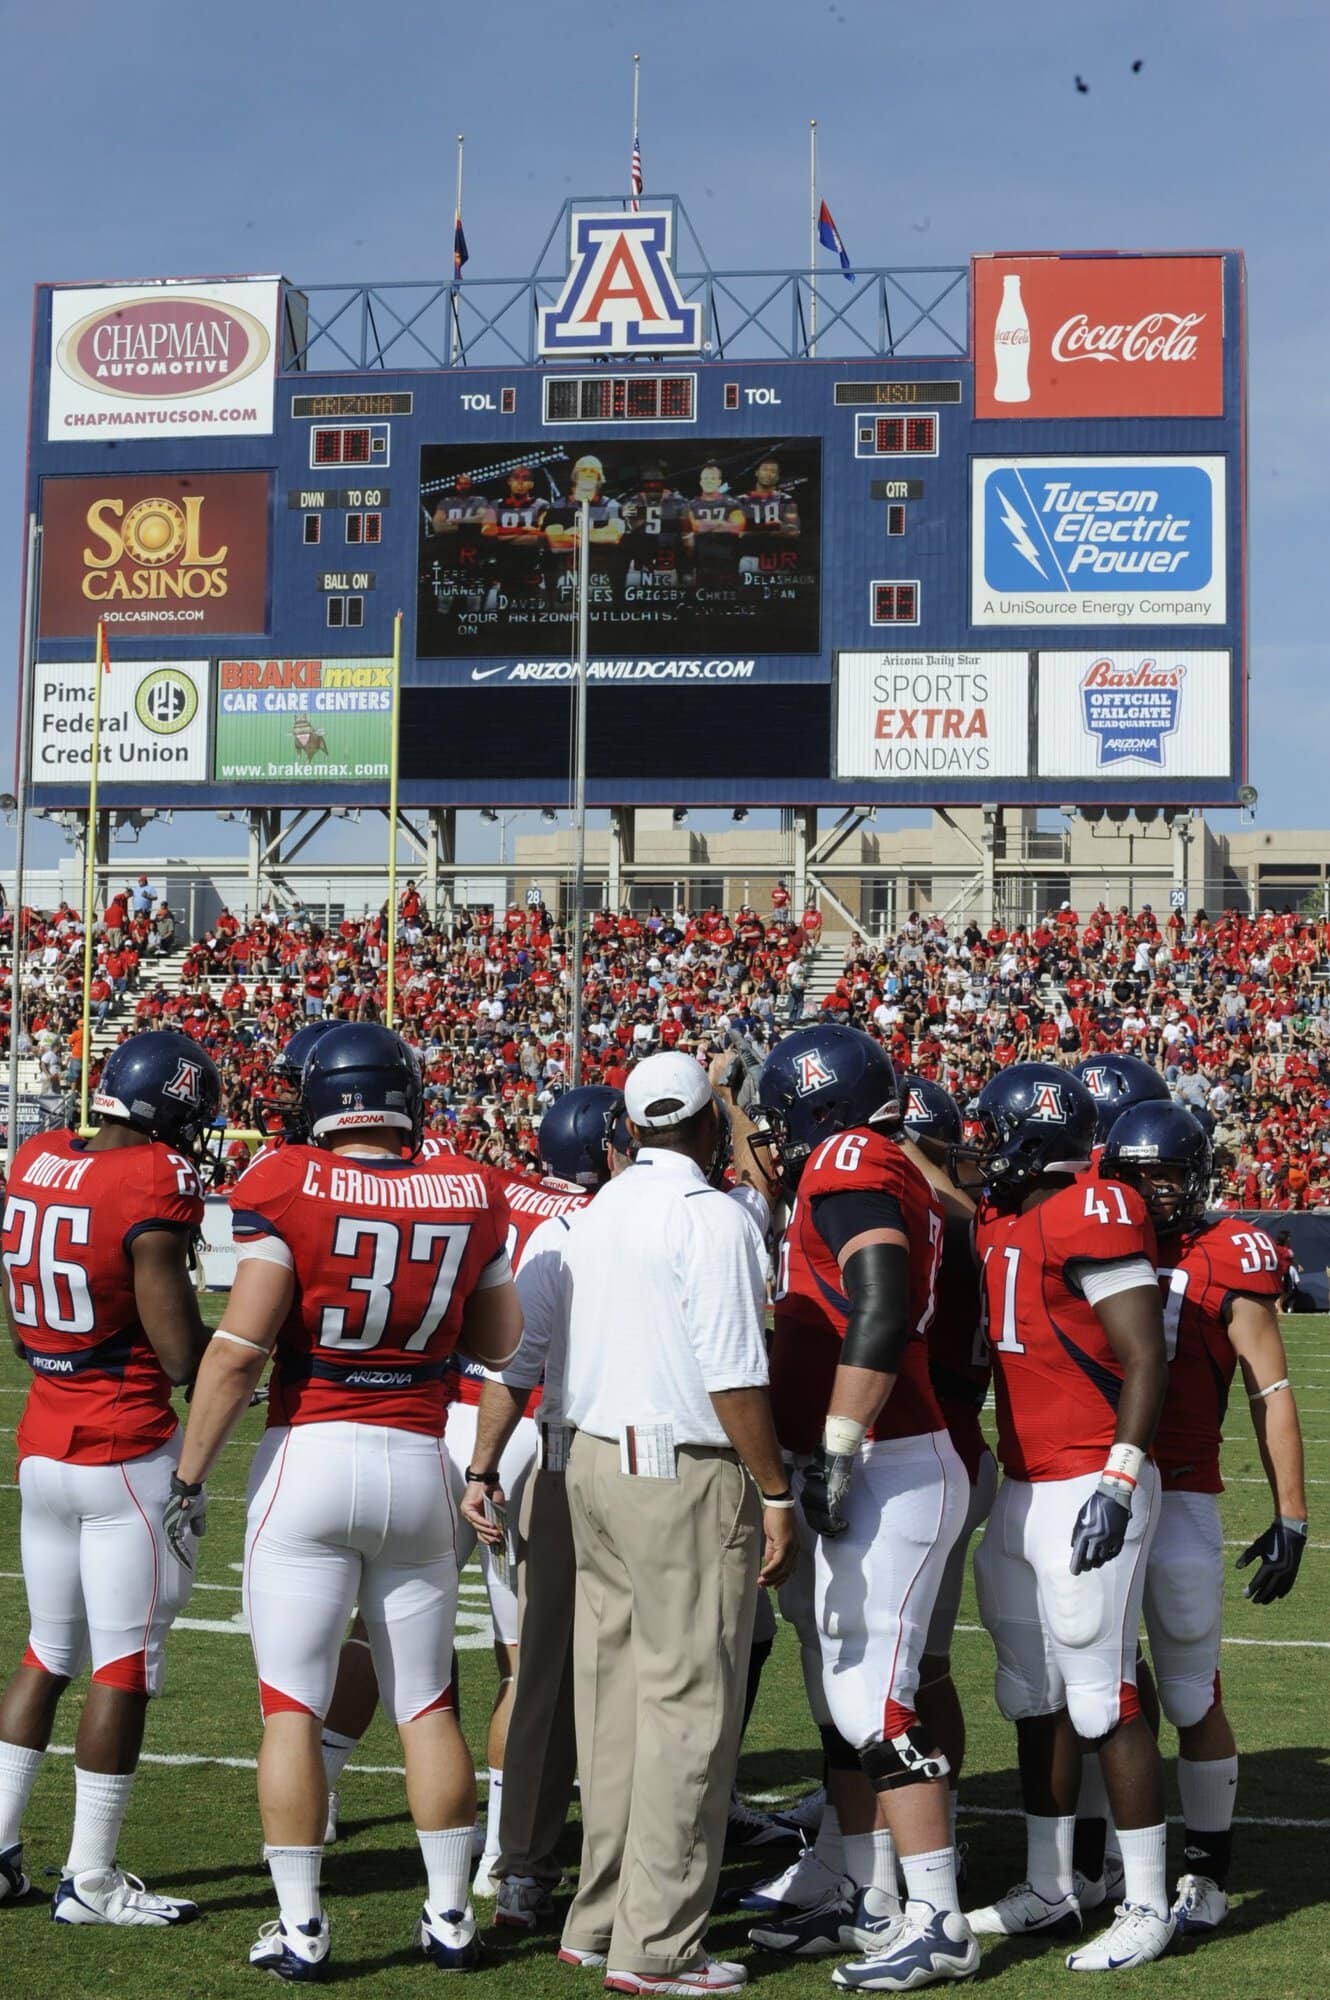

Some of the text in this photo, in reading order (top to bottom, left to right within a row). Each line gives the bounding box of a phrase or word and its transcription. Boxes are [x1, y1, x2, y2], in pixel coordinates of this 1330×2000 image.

[538, 211, 702, 354] A
[93, 321, 232, 361] CHAPMAN
[1051, 312, 1206, 362] Coca-Cola
[96, 360, 229, 377] AUTOMOTIVE
[312, 396, 393, 416] ARIZONA
[461, 394, 497, 411] TOL
[744, 388, 781, 406] TOL
[64, 408, 257, 426] CHAPMANTUCSON.COM
[301, 492, 324, 507] DWN
[348, 490, 381, 506] TO GO
[886, 481, 908, 498] QTR
[1042, 482, 1158, 513] Tucson
[83, 496, 228, 568] SOL
[1053, 514, 1190, 542] Electric
[1068, 544, 1189, 574] Power
[81, 567, 228, 601] CASINOS
[324, 573, 368, 589] BALL ON
[103, 610, 204, 622] SOLCASINOS.COM
[983, 600, 1211, 616] A UniSource Energy Company
[881, 654, 981, 668] Arizona Daily Star
[220, 661, 394, 690] BRAKE max
[1085, 662, 1183, 687] Bashas'
[873, 674, 989, 703] SPORTS
[223, 691, 391, 712] CAR CARE CENTERS
[1091, 694, 1171, 706] OFFICIAL
[1090, 707, 1171, 719] TAILGATE
[874, 708, 988, 739] EXTRA
[1091, 720, 1171, 729] HEADQUARTERS
[119, 743, 189, 763] Union
[1104, 739, 1158, 749] ARIZONA
[874, 747, 990, 771] MONDAYS
[221, 762, 389, 778] www.brakemax.com
[527, 890, 540, 904] 28
[1171, 891, 1185, 905] 29
[337, 1114, 384, 1126] ARIZONA
[813, 1134, 868, 1171] 76
[302, 1160, 325, 1198] C.
[330, 1168, 489, 1209] GRONKOWSKI
[504, 1183, 588, 1216] VARGAS
[1084, 1186, 1132, 1225] 41
[1231, 1232, 1278, 1273] 39
[3, 1196, 94, 1333] 26
[319, 1217, 472, 1351] 37
[346, 1371, 413, 1385] ARIZONA
